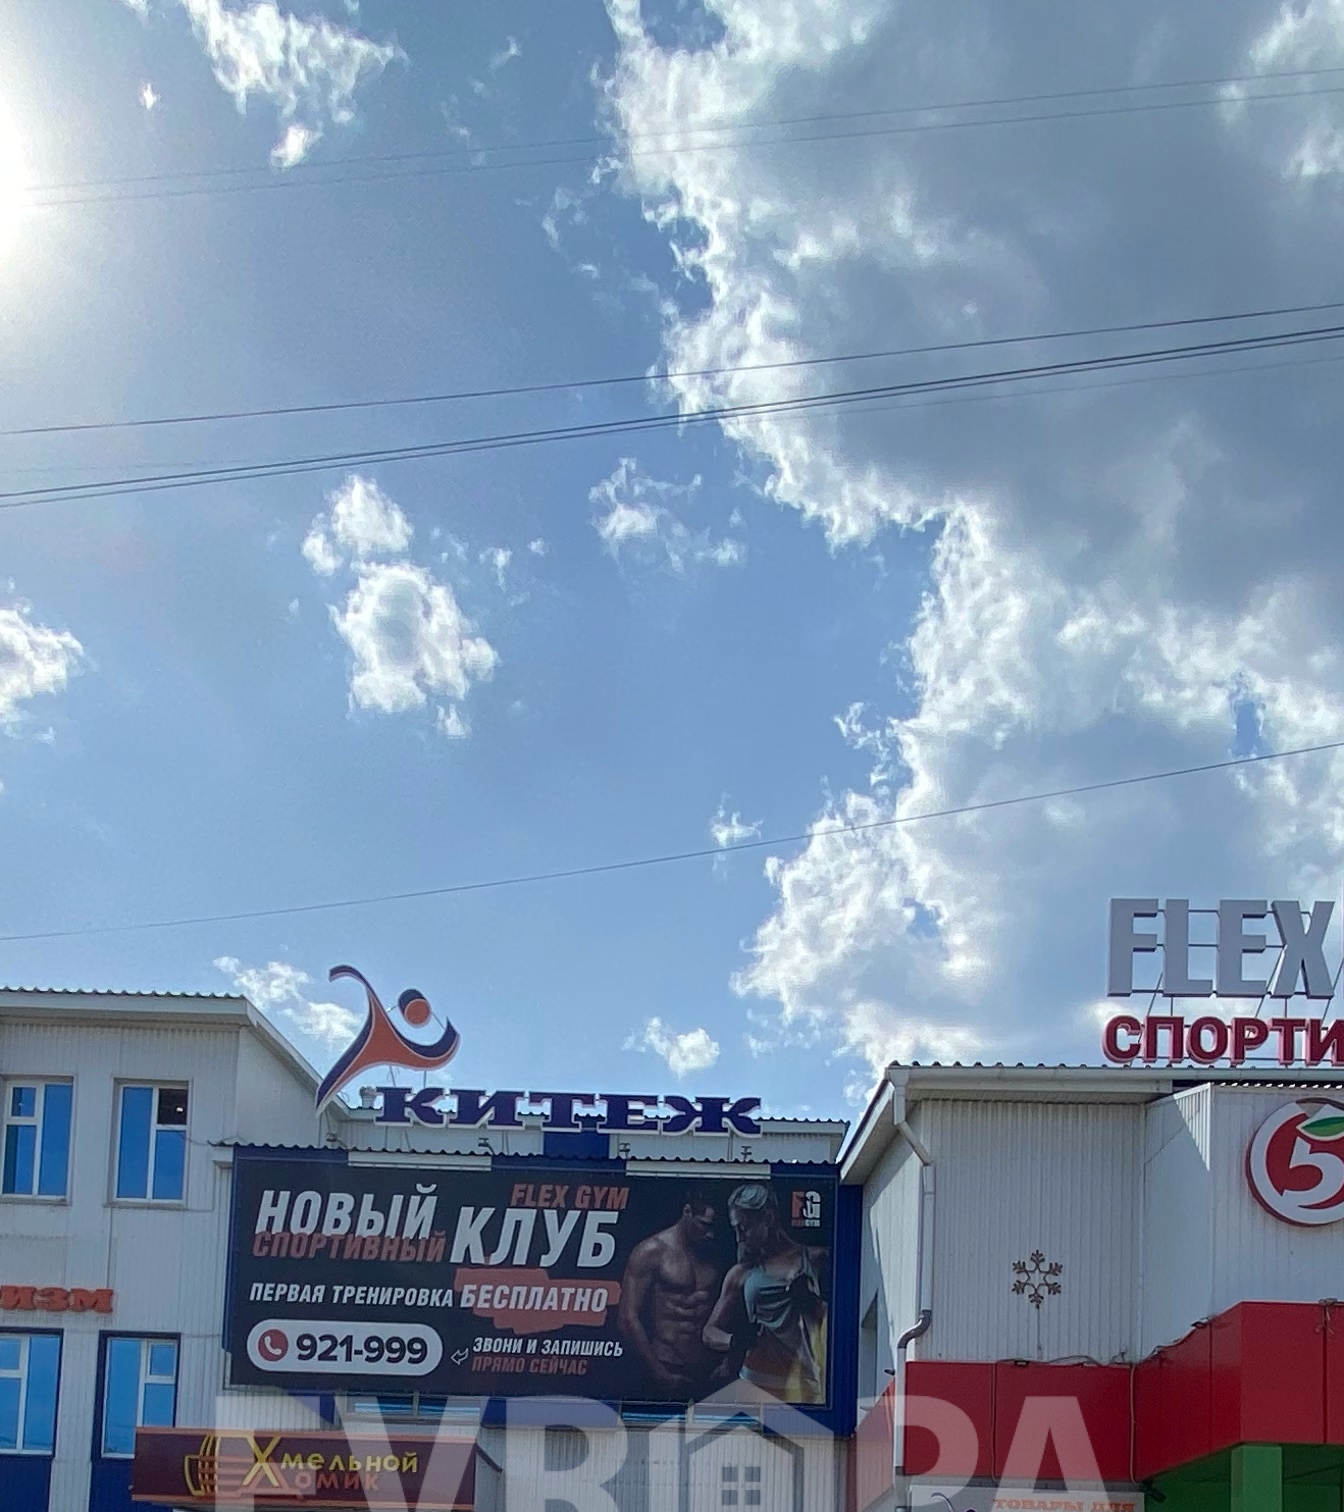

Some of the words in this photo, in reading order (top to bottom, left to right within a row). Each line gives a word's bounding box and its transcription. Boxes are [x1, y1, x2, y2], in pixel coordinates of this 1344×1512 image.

[1107, 897, 1335, 999] FLEX
[374, 1086, 762, 1138] КИТЕЖ
[510, 1183, 566, 1209] FLEX
[573, 1185, 630, 1211] GYM
[255, 1183, 438, 1240] НОВЫЙ
[449, 1205, 620, 1269] КЛУБ
[252, 1230, 446, 1263] СПОРТИВНЫЙ
[249, 1283, 325, 1304] ПЕРВАЯ
[331, 1285, 453, 1308] ТРЕНИРОВКА
[460, 1284, 609, 1313] БЕСПЛАТНО
[295, 1332, 428, 1364] 921-999
[472, 1336, 523, 1354] ЗВОНИ
[526, 1338, 537, 1354] И
[541, 1338, 624, 1357] ЗАПИШИСЬ
[472, 1356, 526, 1373] ПРЯМО
[528, 1355, 588, 1375] СЕЙЧАС
[242, 1436, 419, 1488] Хмельной
[993, 1498, 1083, 1512] ТОВАРЫ
